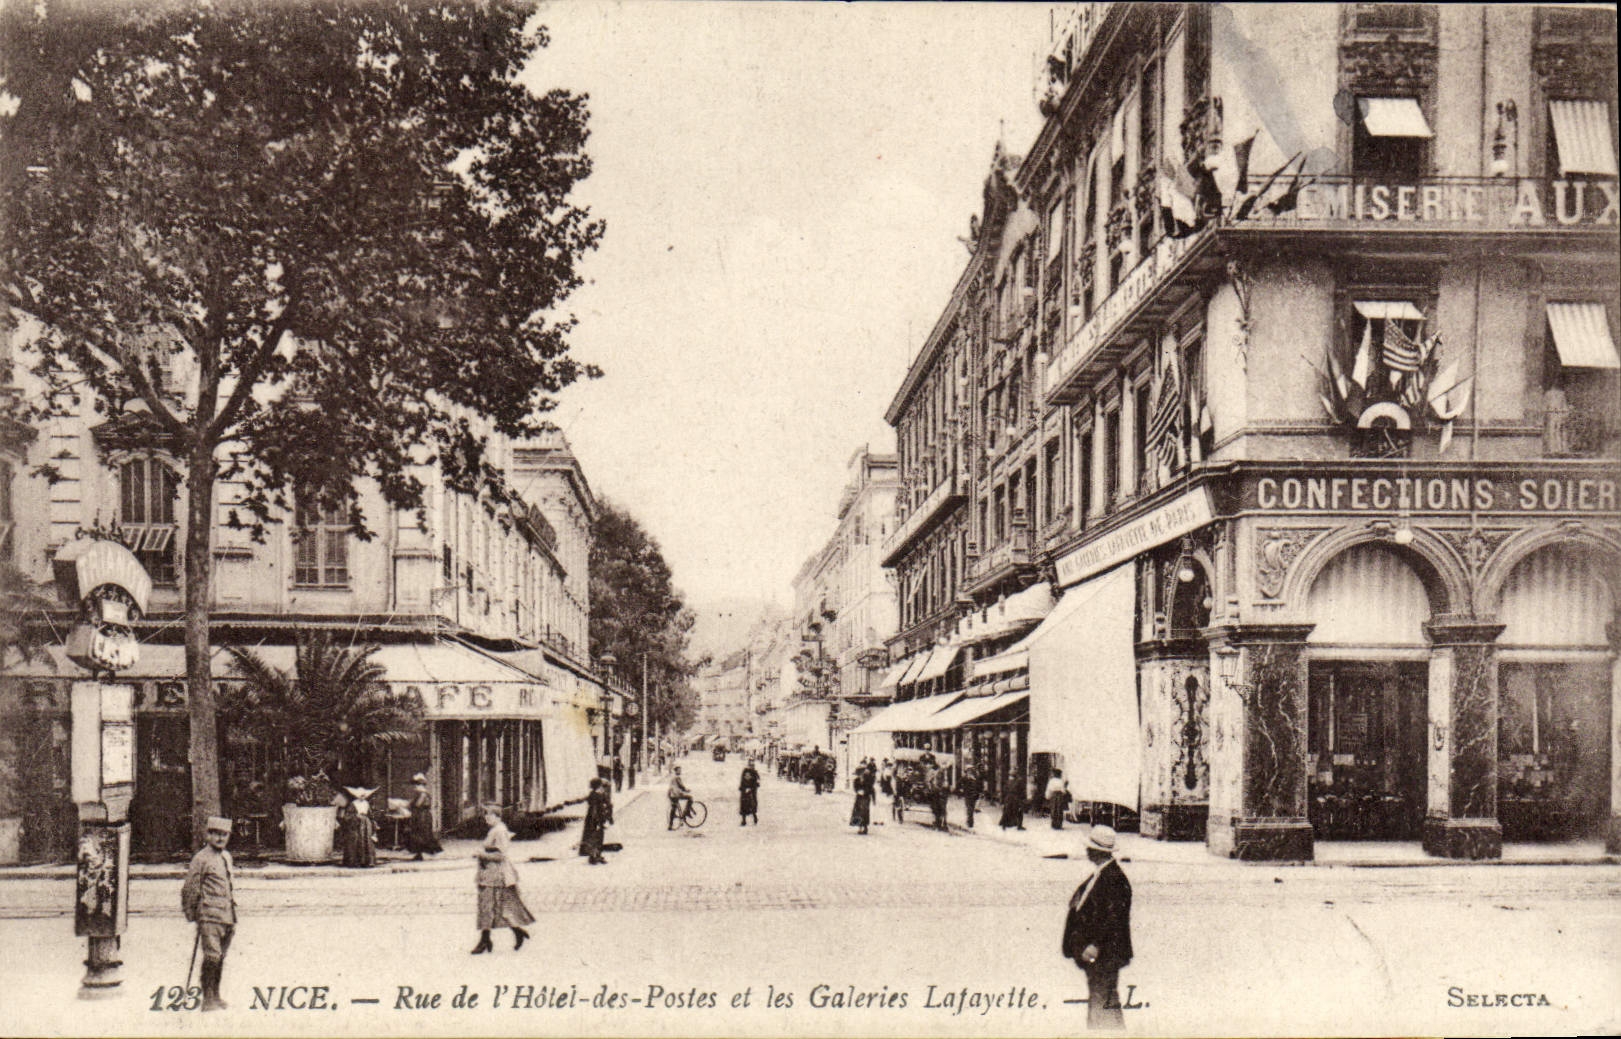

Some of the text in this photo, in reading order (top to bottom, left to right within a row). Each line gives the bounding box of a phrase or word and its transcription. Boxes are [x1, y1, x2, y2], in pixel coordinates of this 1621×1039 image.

[1257, 478, 1617, 510] CONFECTIONS SOIER
[1149, 517, 1165, 538] DE
